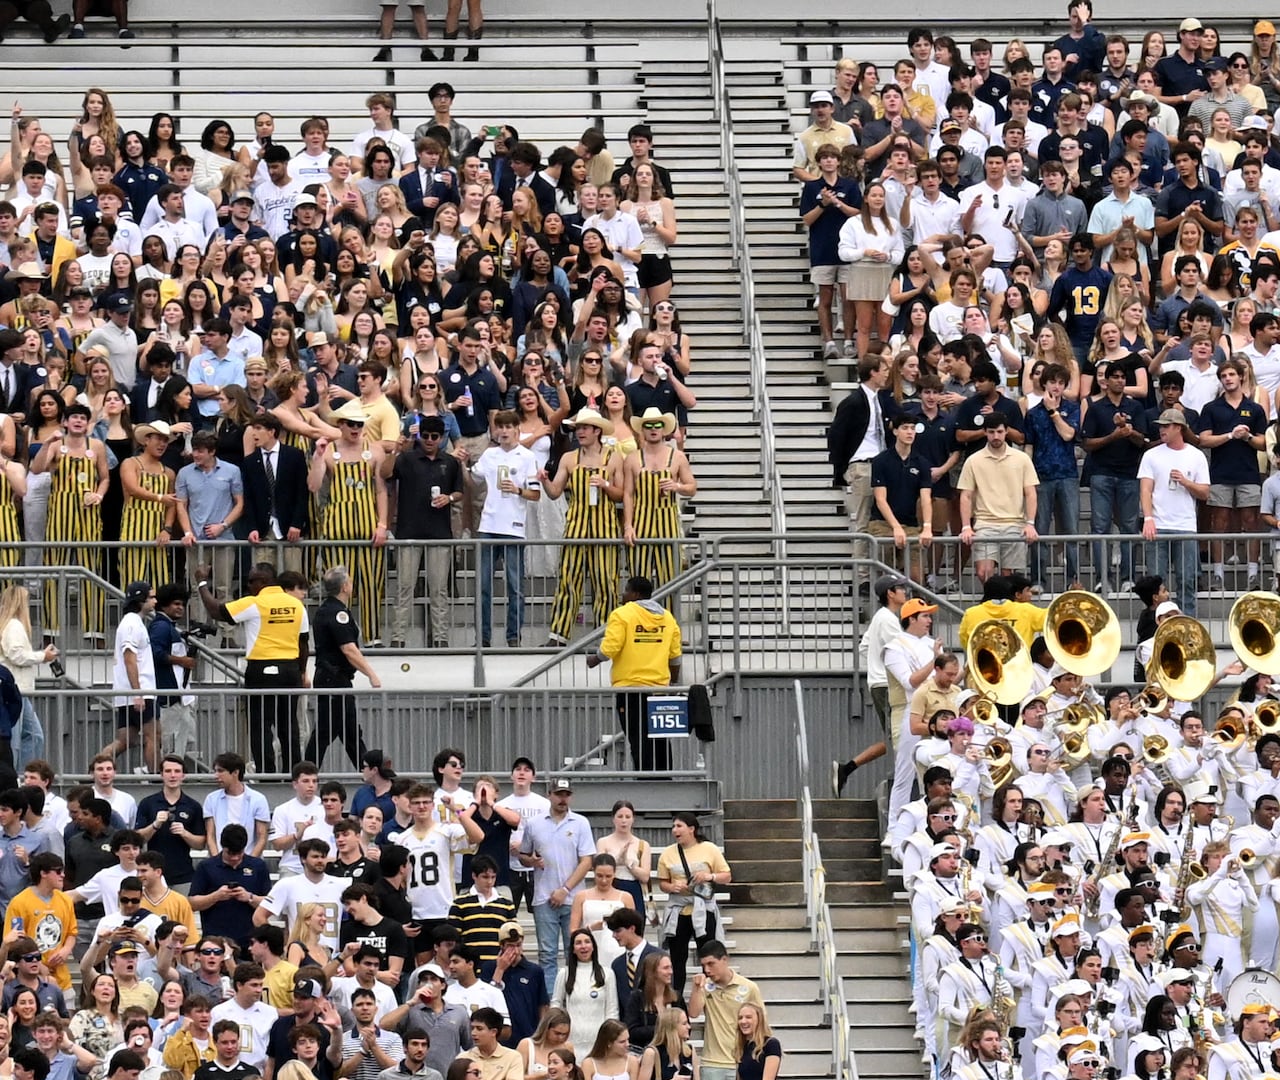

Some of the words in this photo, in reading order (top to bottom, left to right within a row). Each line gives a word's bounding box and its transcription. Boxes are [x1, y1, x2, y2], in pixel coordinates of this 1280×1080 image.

[263, 196, 296, 211] Jacket
[1072, 286, 1100, 314] 13
[270, 607, 297, 616] BEST
[636, 624, 666, 634] BEST
[650, 714, 685, 729] 115L
[410, 852, 438, 888] 18
[358, 937, 387, 947] TECH
